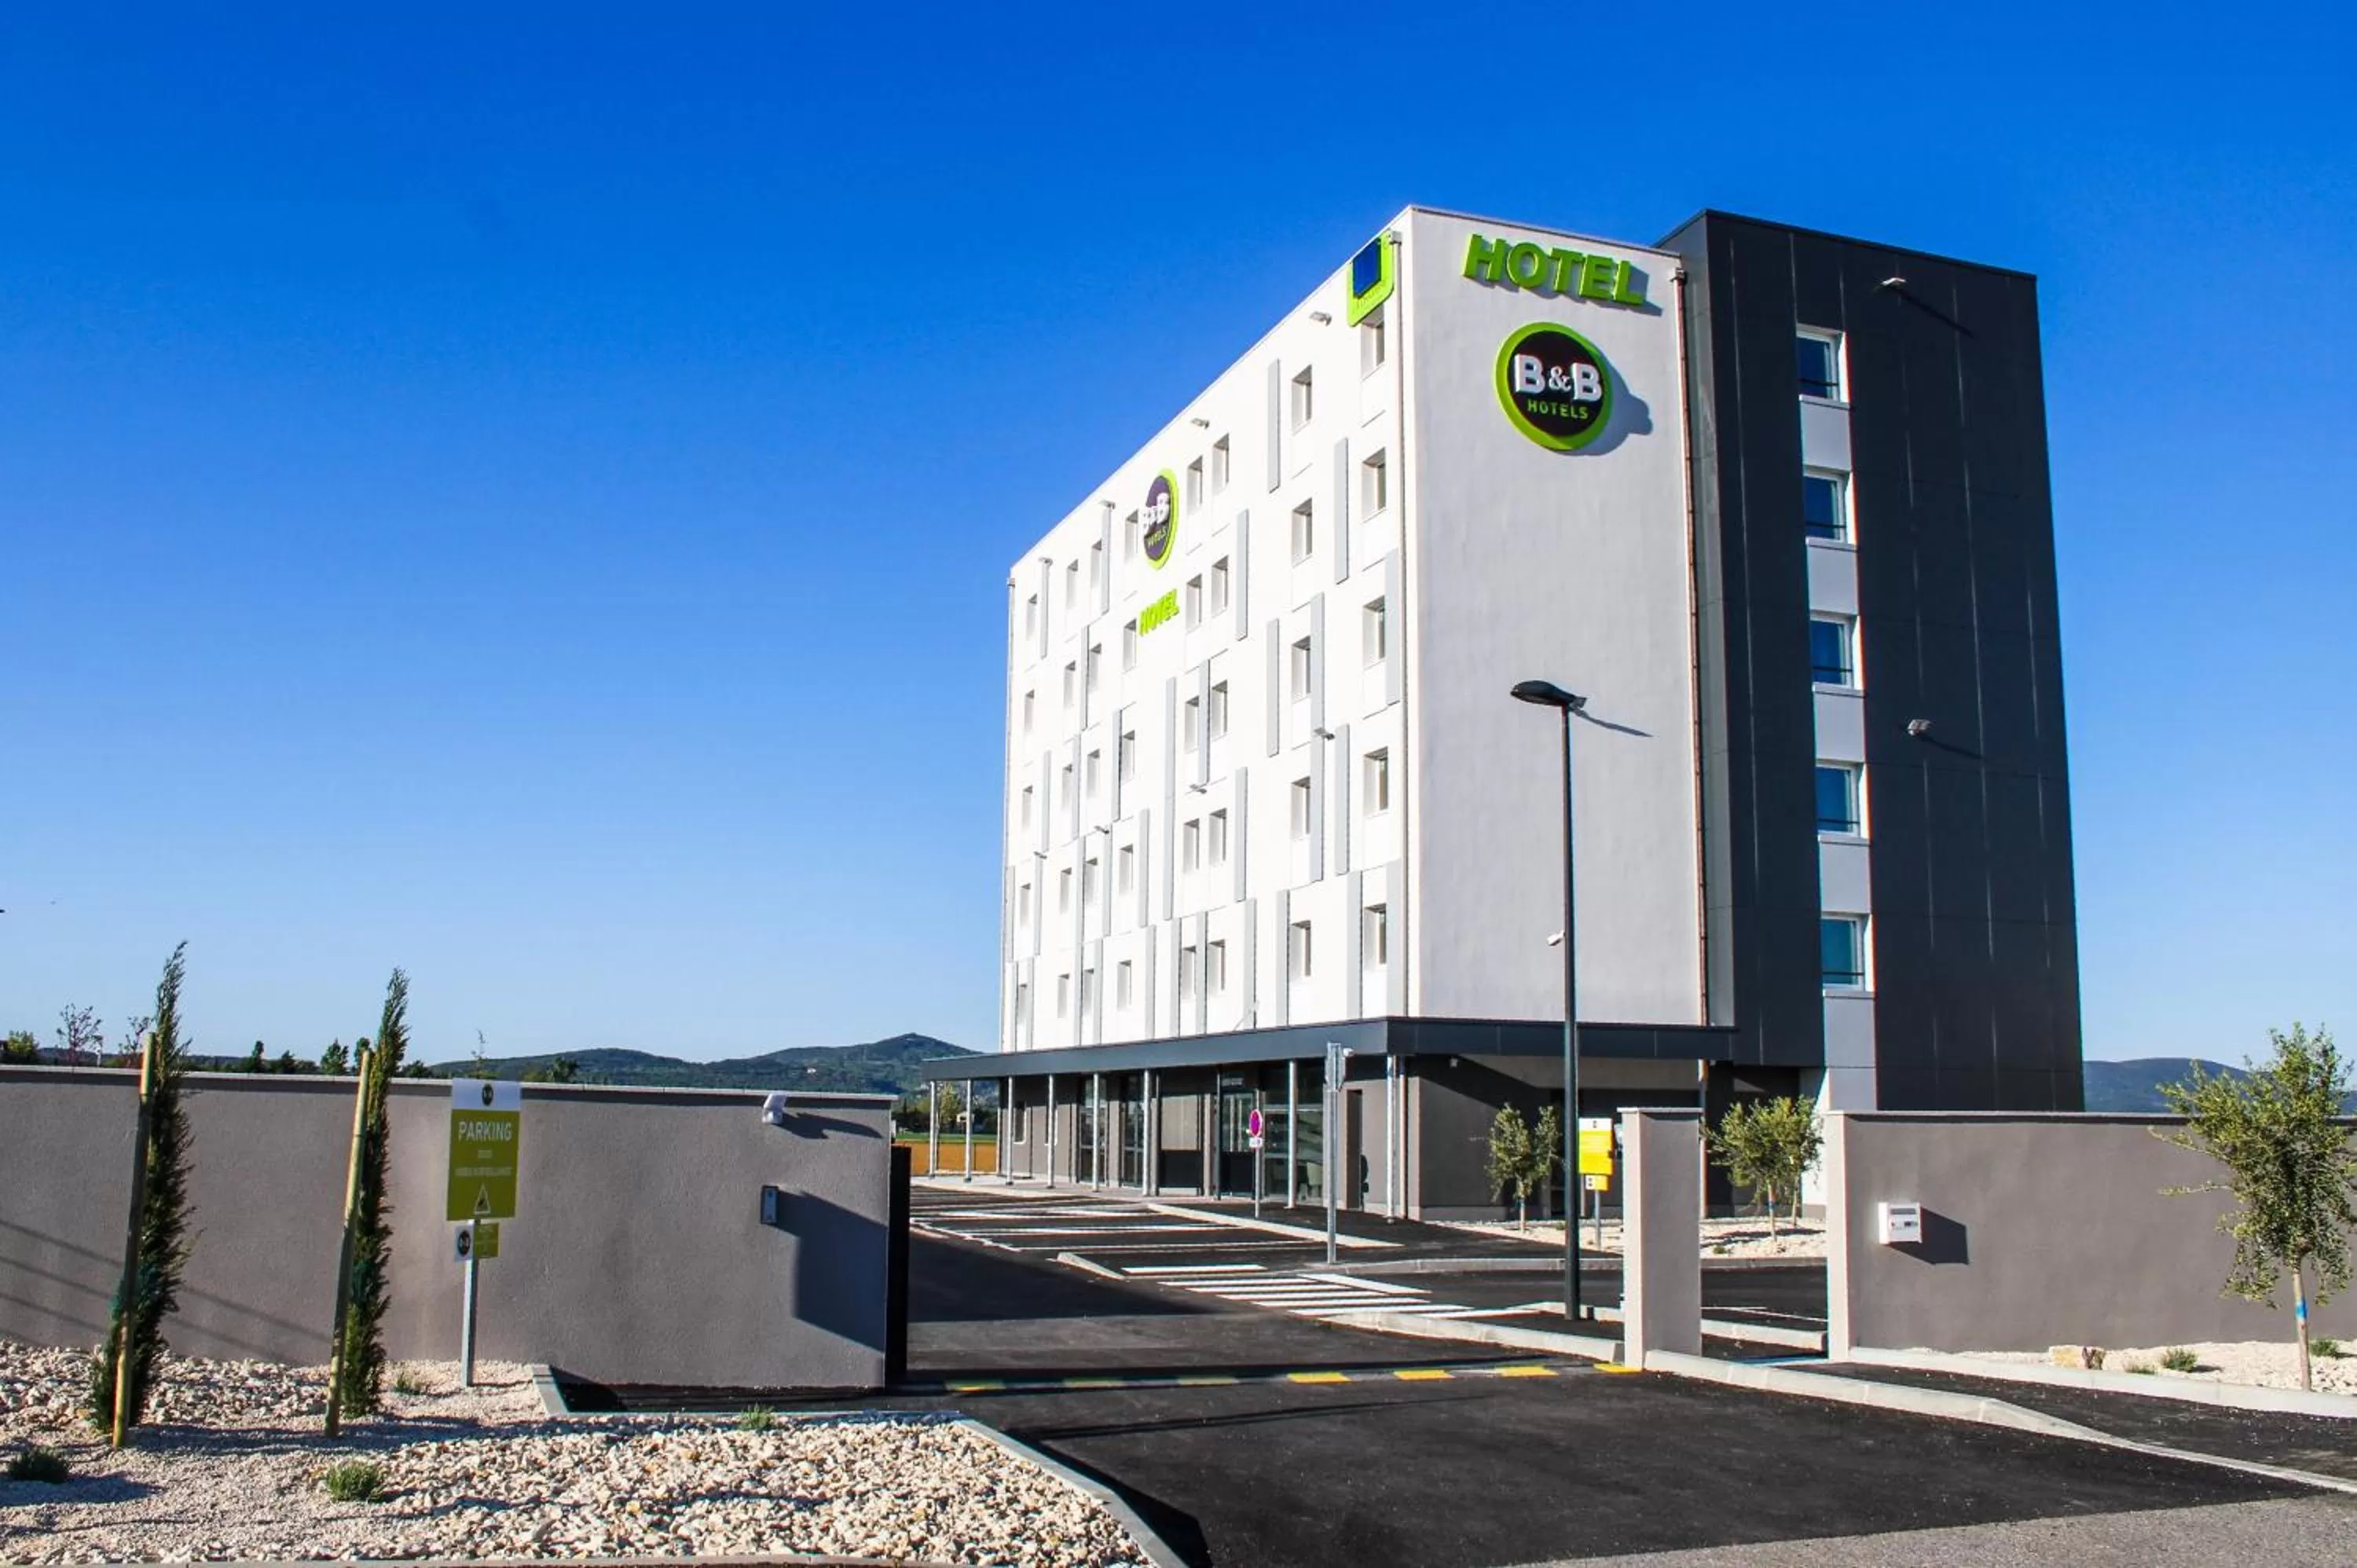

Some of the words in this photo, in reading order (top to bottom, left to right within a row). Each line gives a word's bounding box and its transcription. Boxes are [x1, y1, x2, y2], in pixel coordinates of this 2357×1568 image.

[1462, 233, 1643, 306] HOTEL
[1515, 354, 1602, 402] B&B
[1527, 399, 1589, 419] HOTELS
[459, 1121, 512, 1141] PARKING
